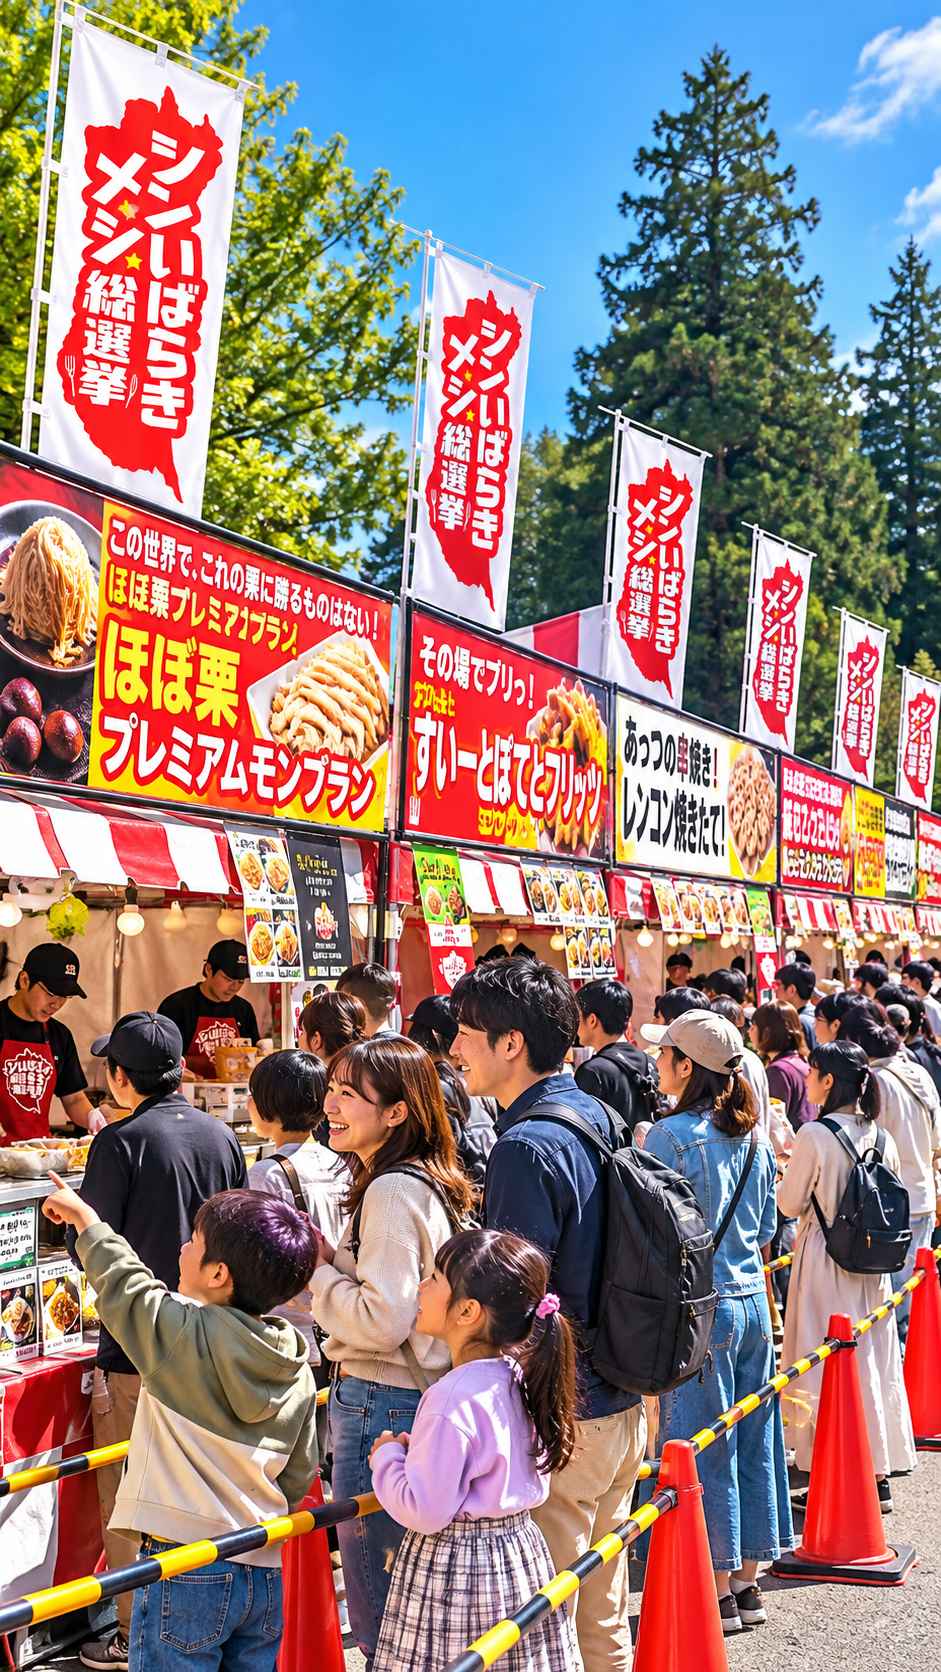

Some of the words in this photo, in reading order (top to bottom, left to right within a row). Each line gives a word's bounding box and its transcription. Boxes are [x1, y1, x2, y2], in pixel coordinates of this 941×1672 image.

[141, 130, 205, 430] シンいばらき
[471, 318, 512, 551] シンいばらき
[655, 485, 685, 654] シンいばらき
[104, 619, 240, 729] ほぼ栗
